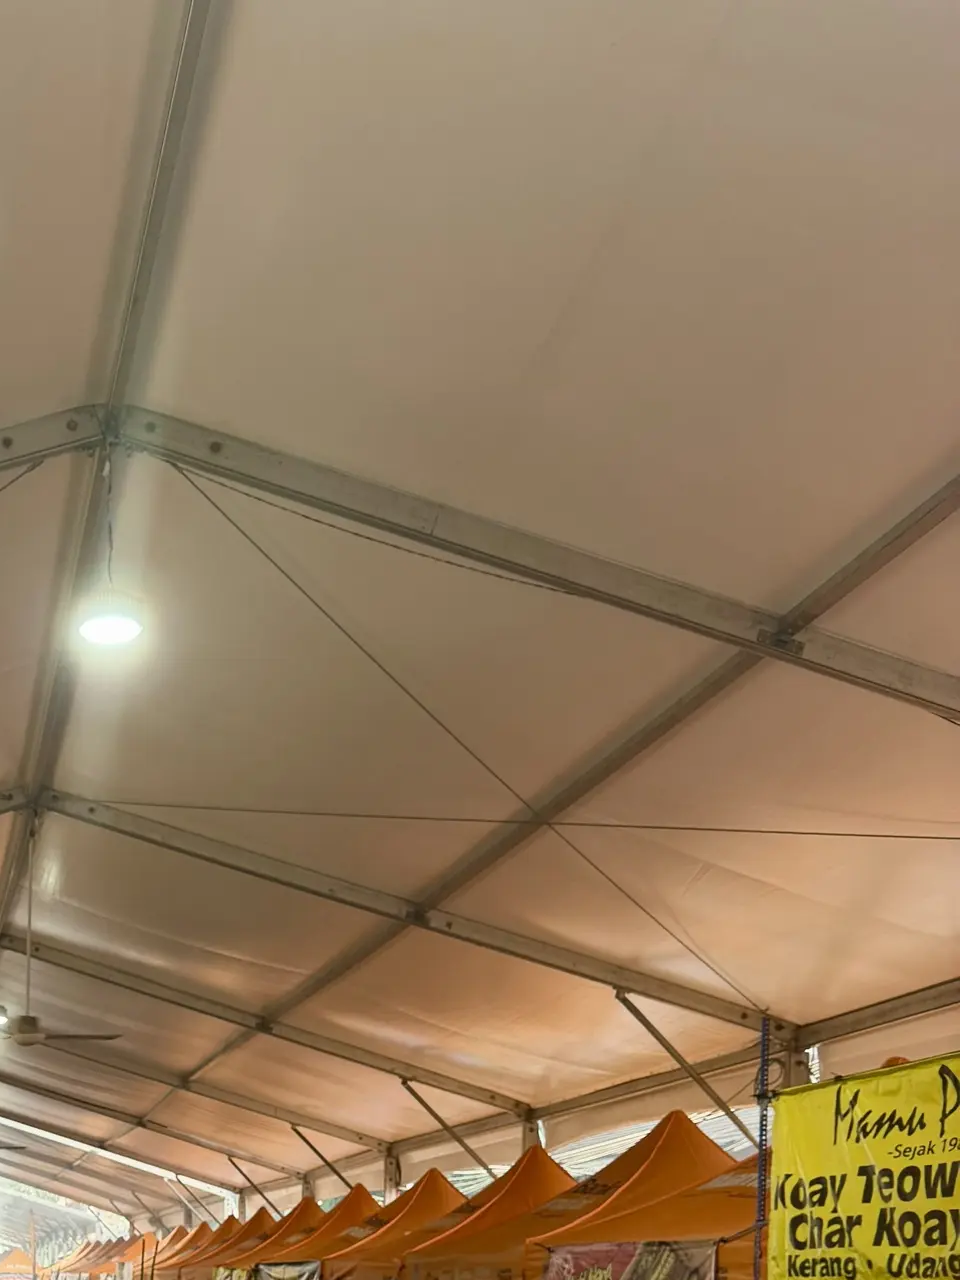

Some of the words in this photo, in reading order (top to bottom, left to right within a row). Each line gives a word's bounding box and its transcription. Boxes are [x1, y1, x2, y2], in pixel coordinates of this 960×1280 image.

[833, 1085, 927, 1145] Mamu
[888, 1140, 936, 1160] -Sejak
[774, 1173, 847, 1213] Koay
[789, 1211, 862, 1251] Char
[788, 1255, 857, 1280] Kerang
[887, 1252, 960, 1280] Udang
